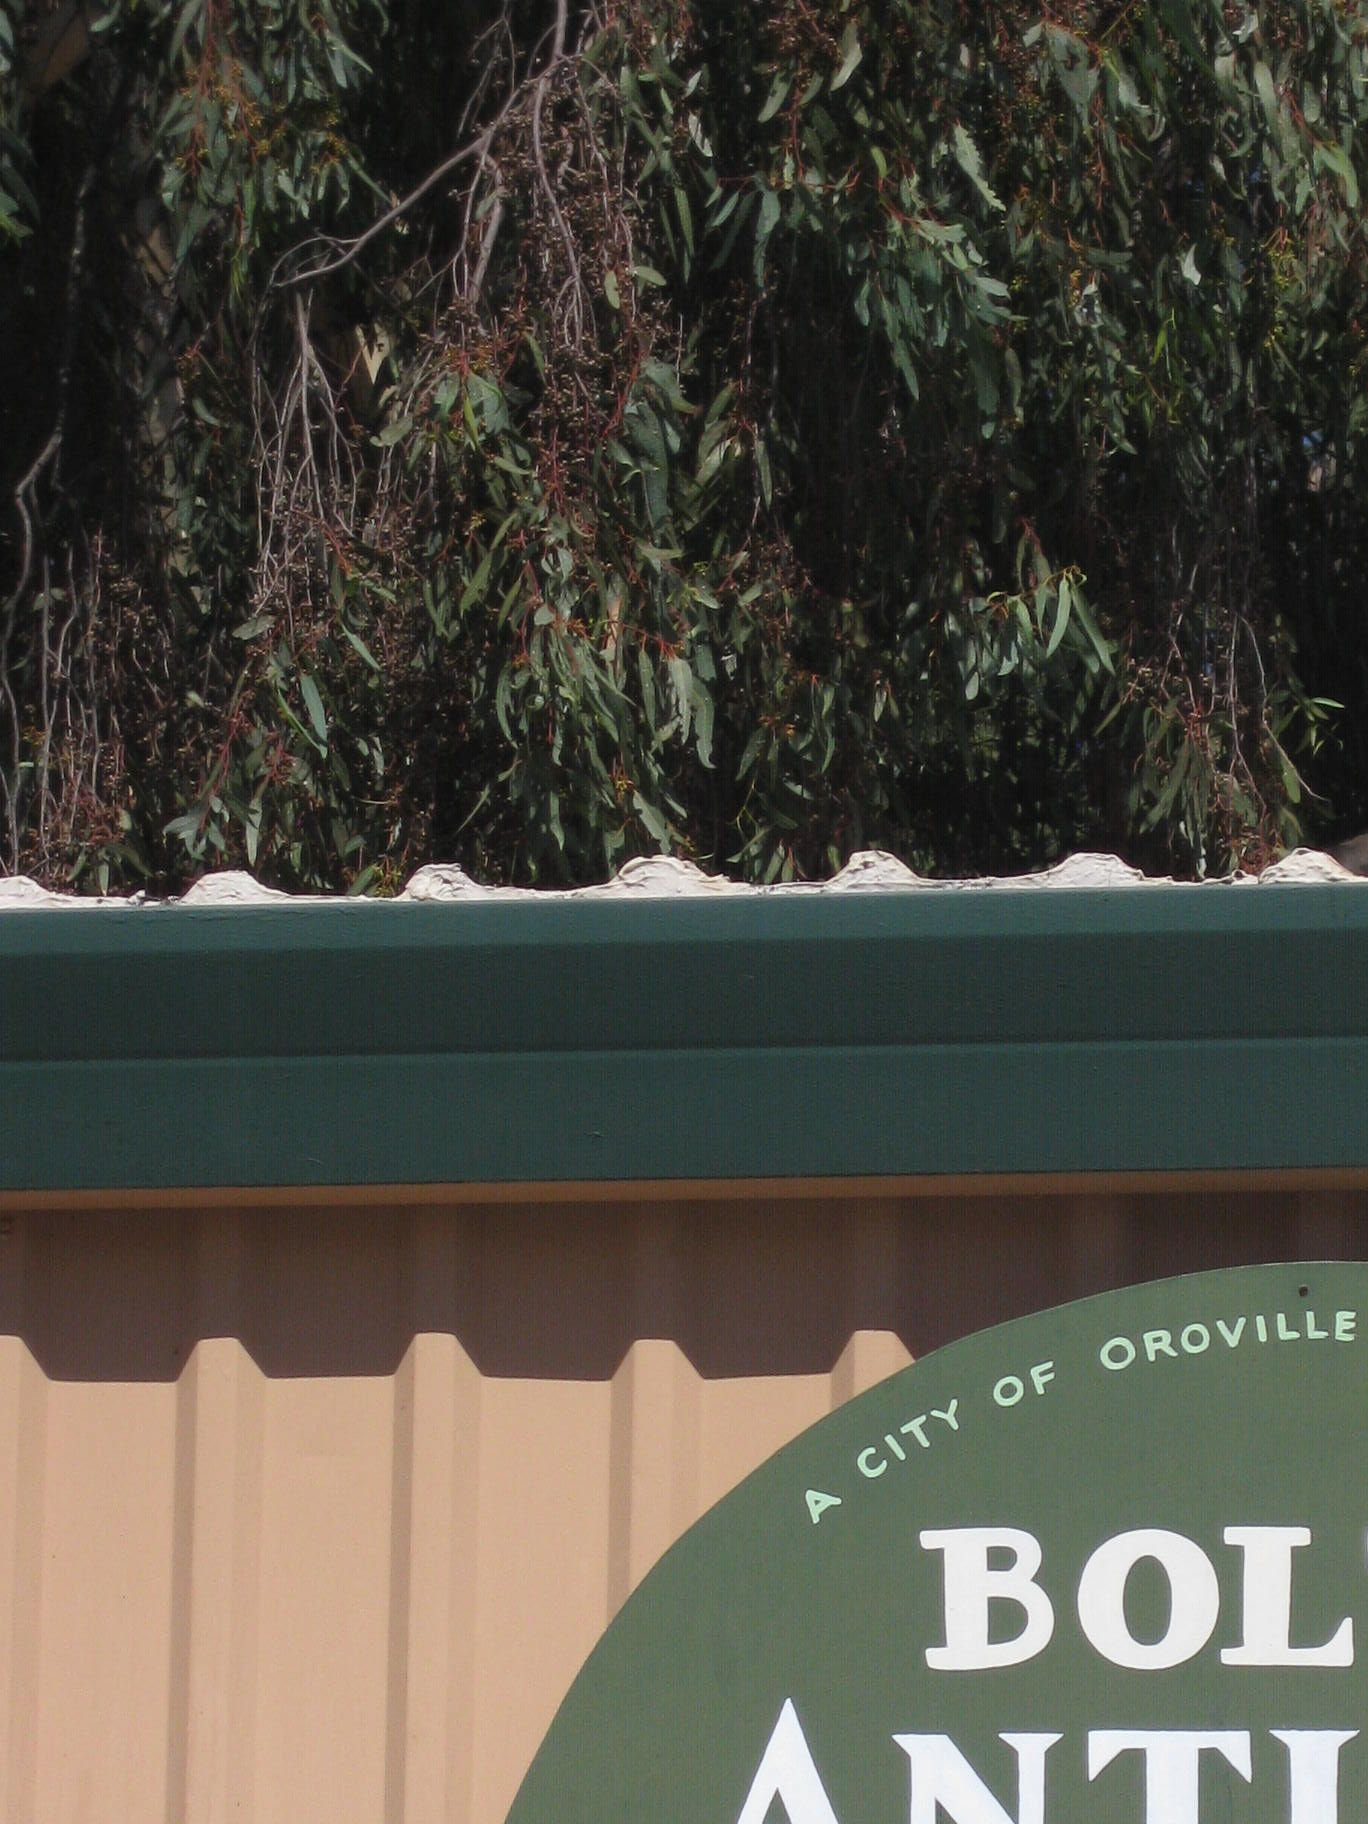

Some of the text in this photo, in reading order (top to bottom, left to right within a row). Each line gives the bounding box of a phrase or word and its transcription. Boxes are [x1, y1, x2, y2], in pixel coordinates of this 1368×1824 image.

[803, 1488, 844, 1526] A
[855, 1397, 961, 1480] CITY
[991, 1359, 1057, 1408] OF
[1098, 1309, 1359, 1372] OROVILLE
